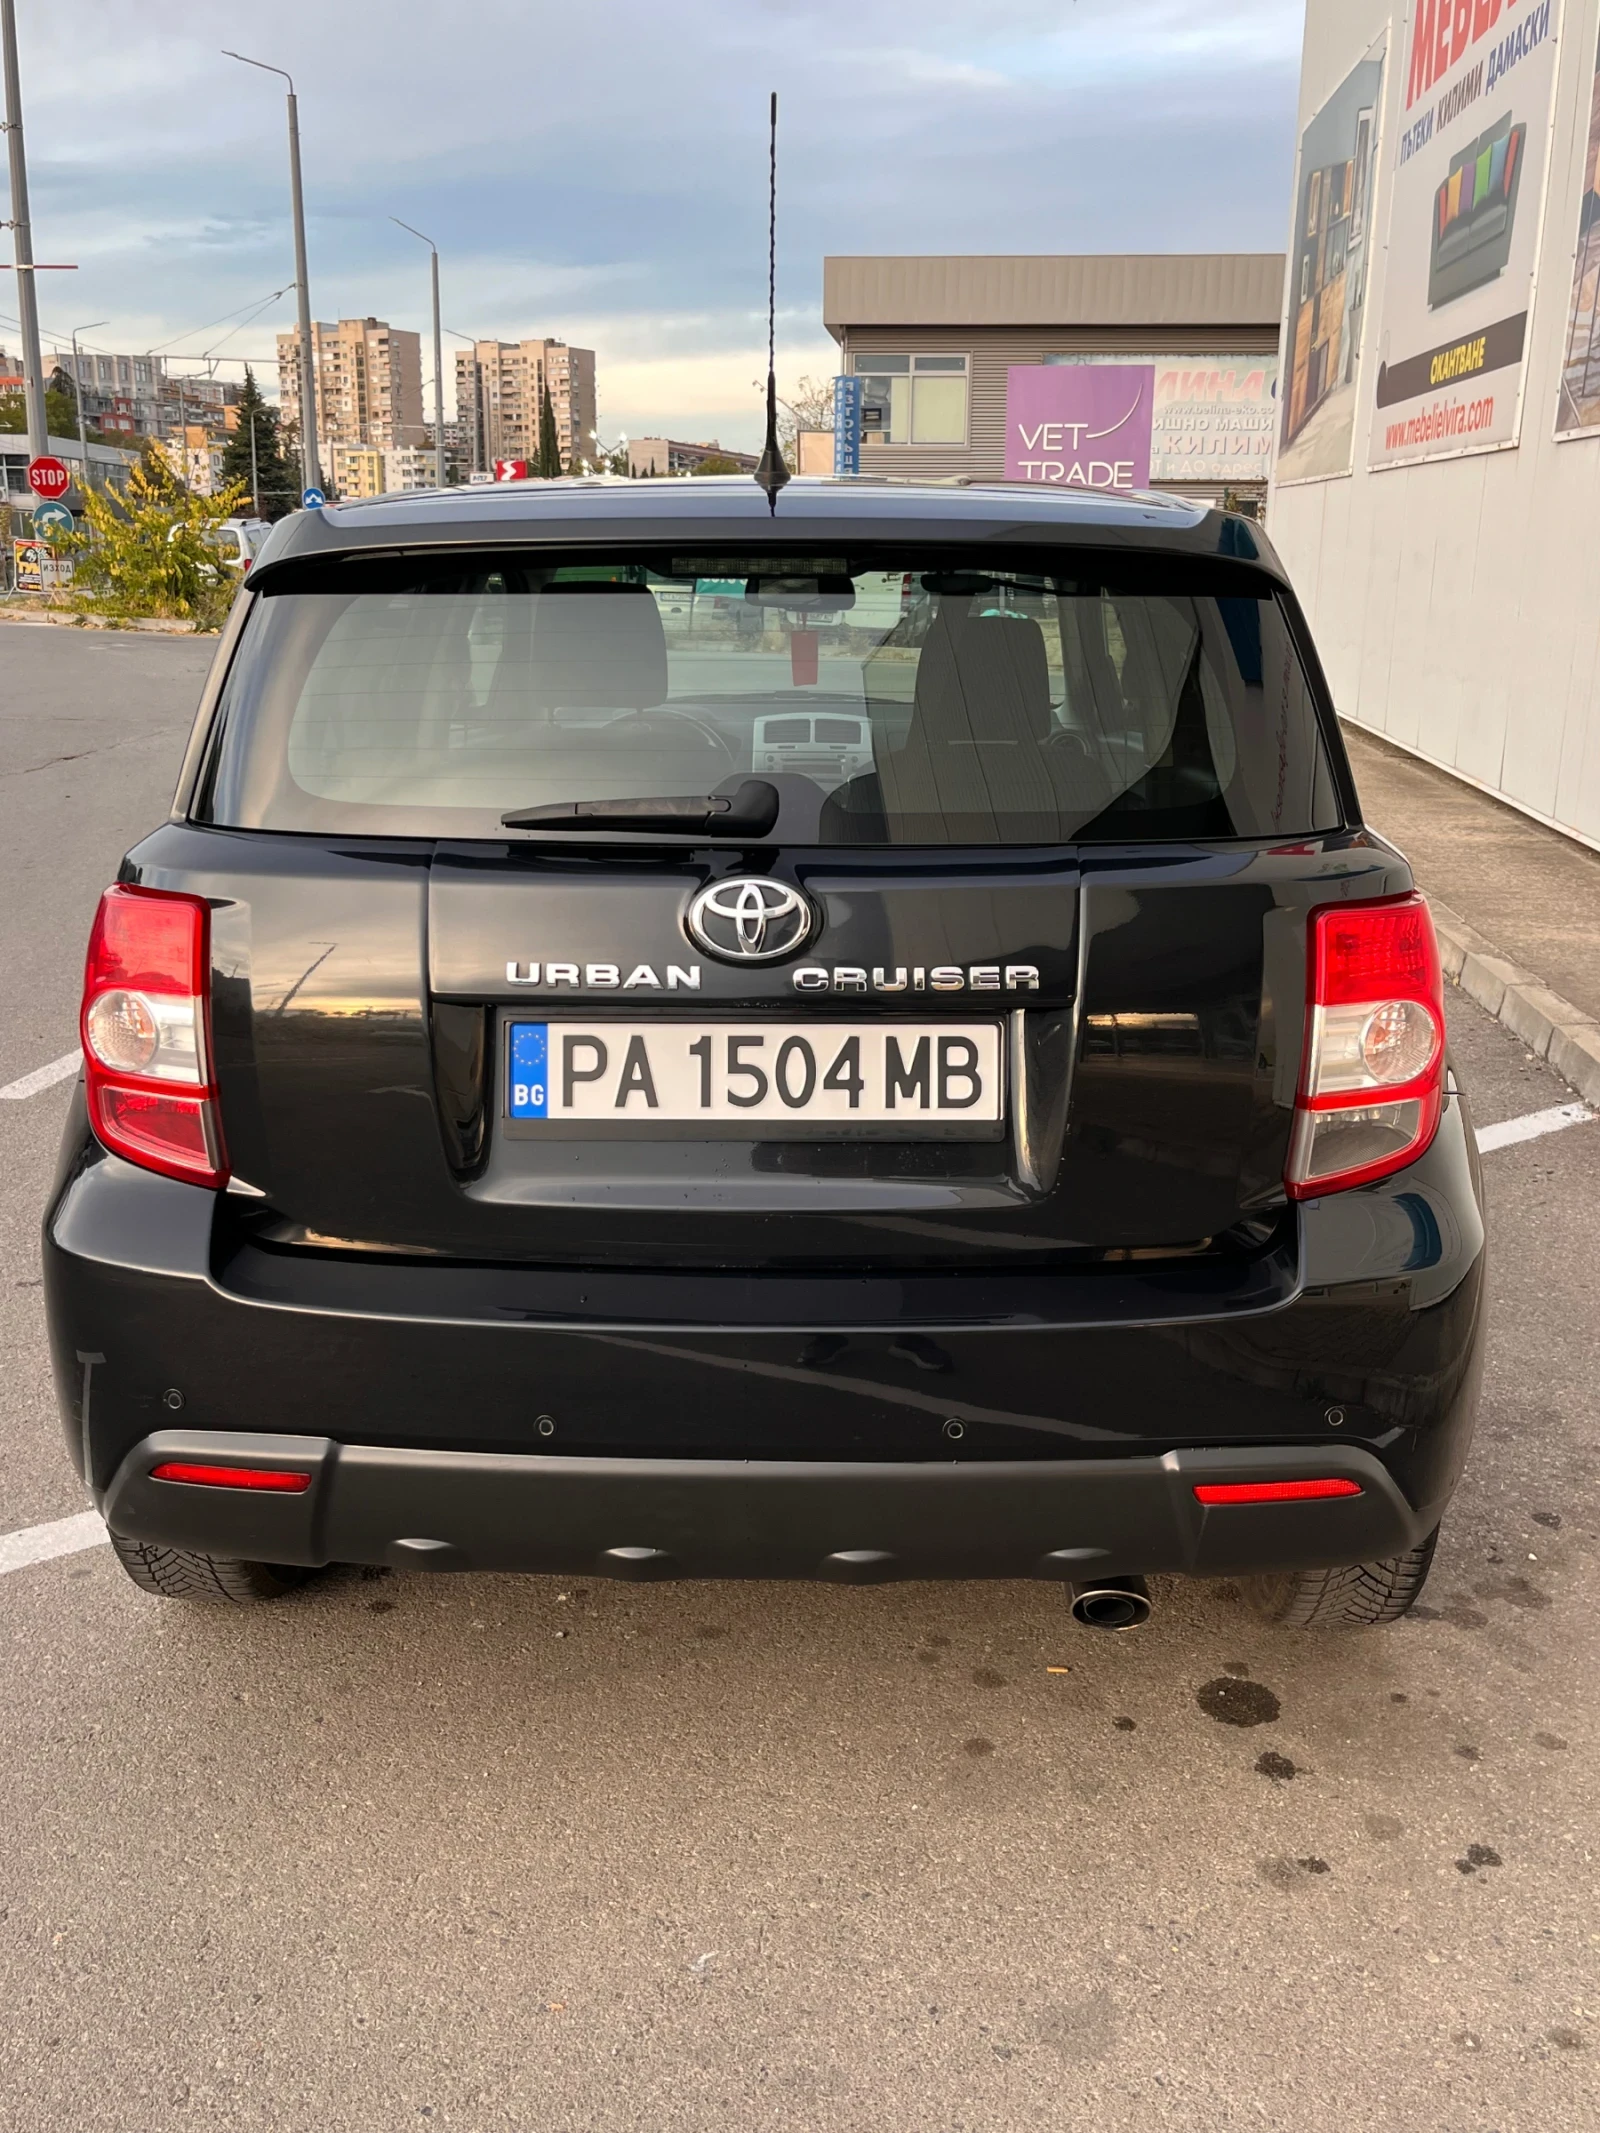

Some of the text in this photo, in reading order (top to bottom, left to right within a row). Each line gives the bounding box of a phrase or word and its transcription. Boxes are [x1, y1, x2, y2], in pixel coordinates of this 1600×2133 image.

[1400, 0, 1550, 166] ПЪТЕКИ КИЛИМИ ДАМАСКИ
[1430, 337, 1486, 384] ОКАНТВАНЕ
[1018, 423, 1088, 450] VET
[1386, 396, 1493, 450] www.mebelielvira.com
[31, 469, 65, 486] STOP
[1017, 461, 1134, 488] TRADE
[43, 564, 71, 573] ИЗХОД
[506, 962, 1039, 992] URBAN CRUISER
[563, 1035, 982, 1109] PA 1504 MB
[514, 1084, 544, 1106] BG
